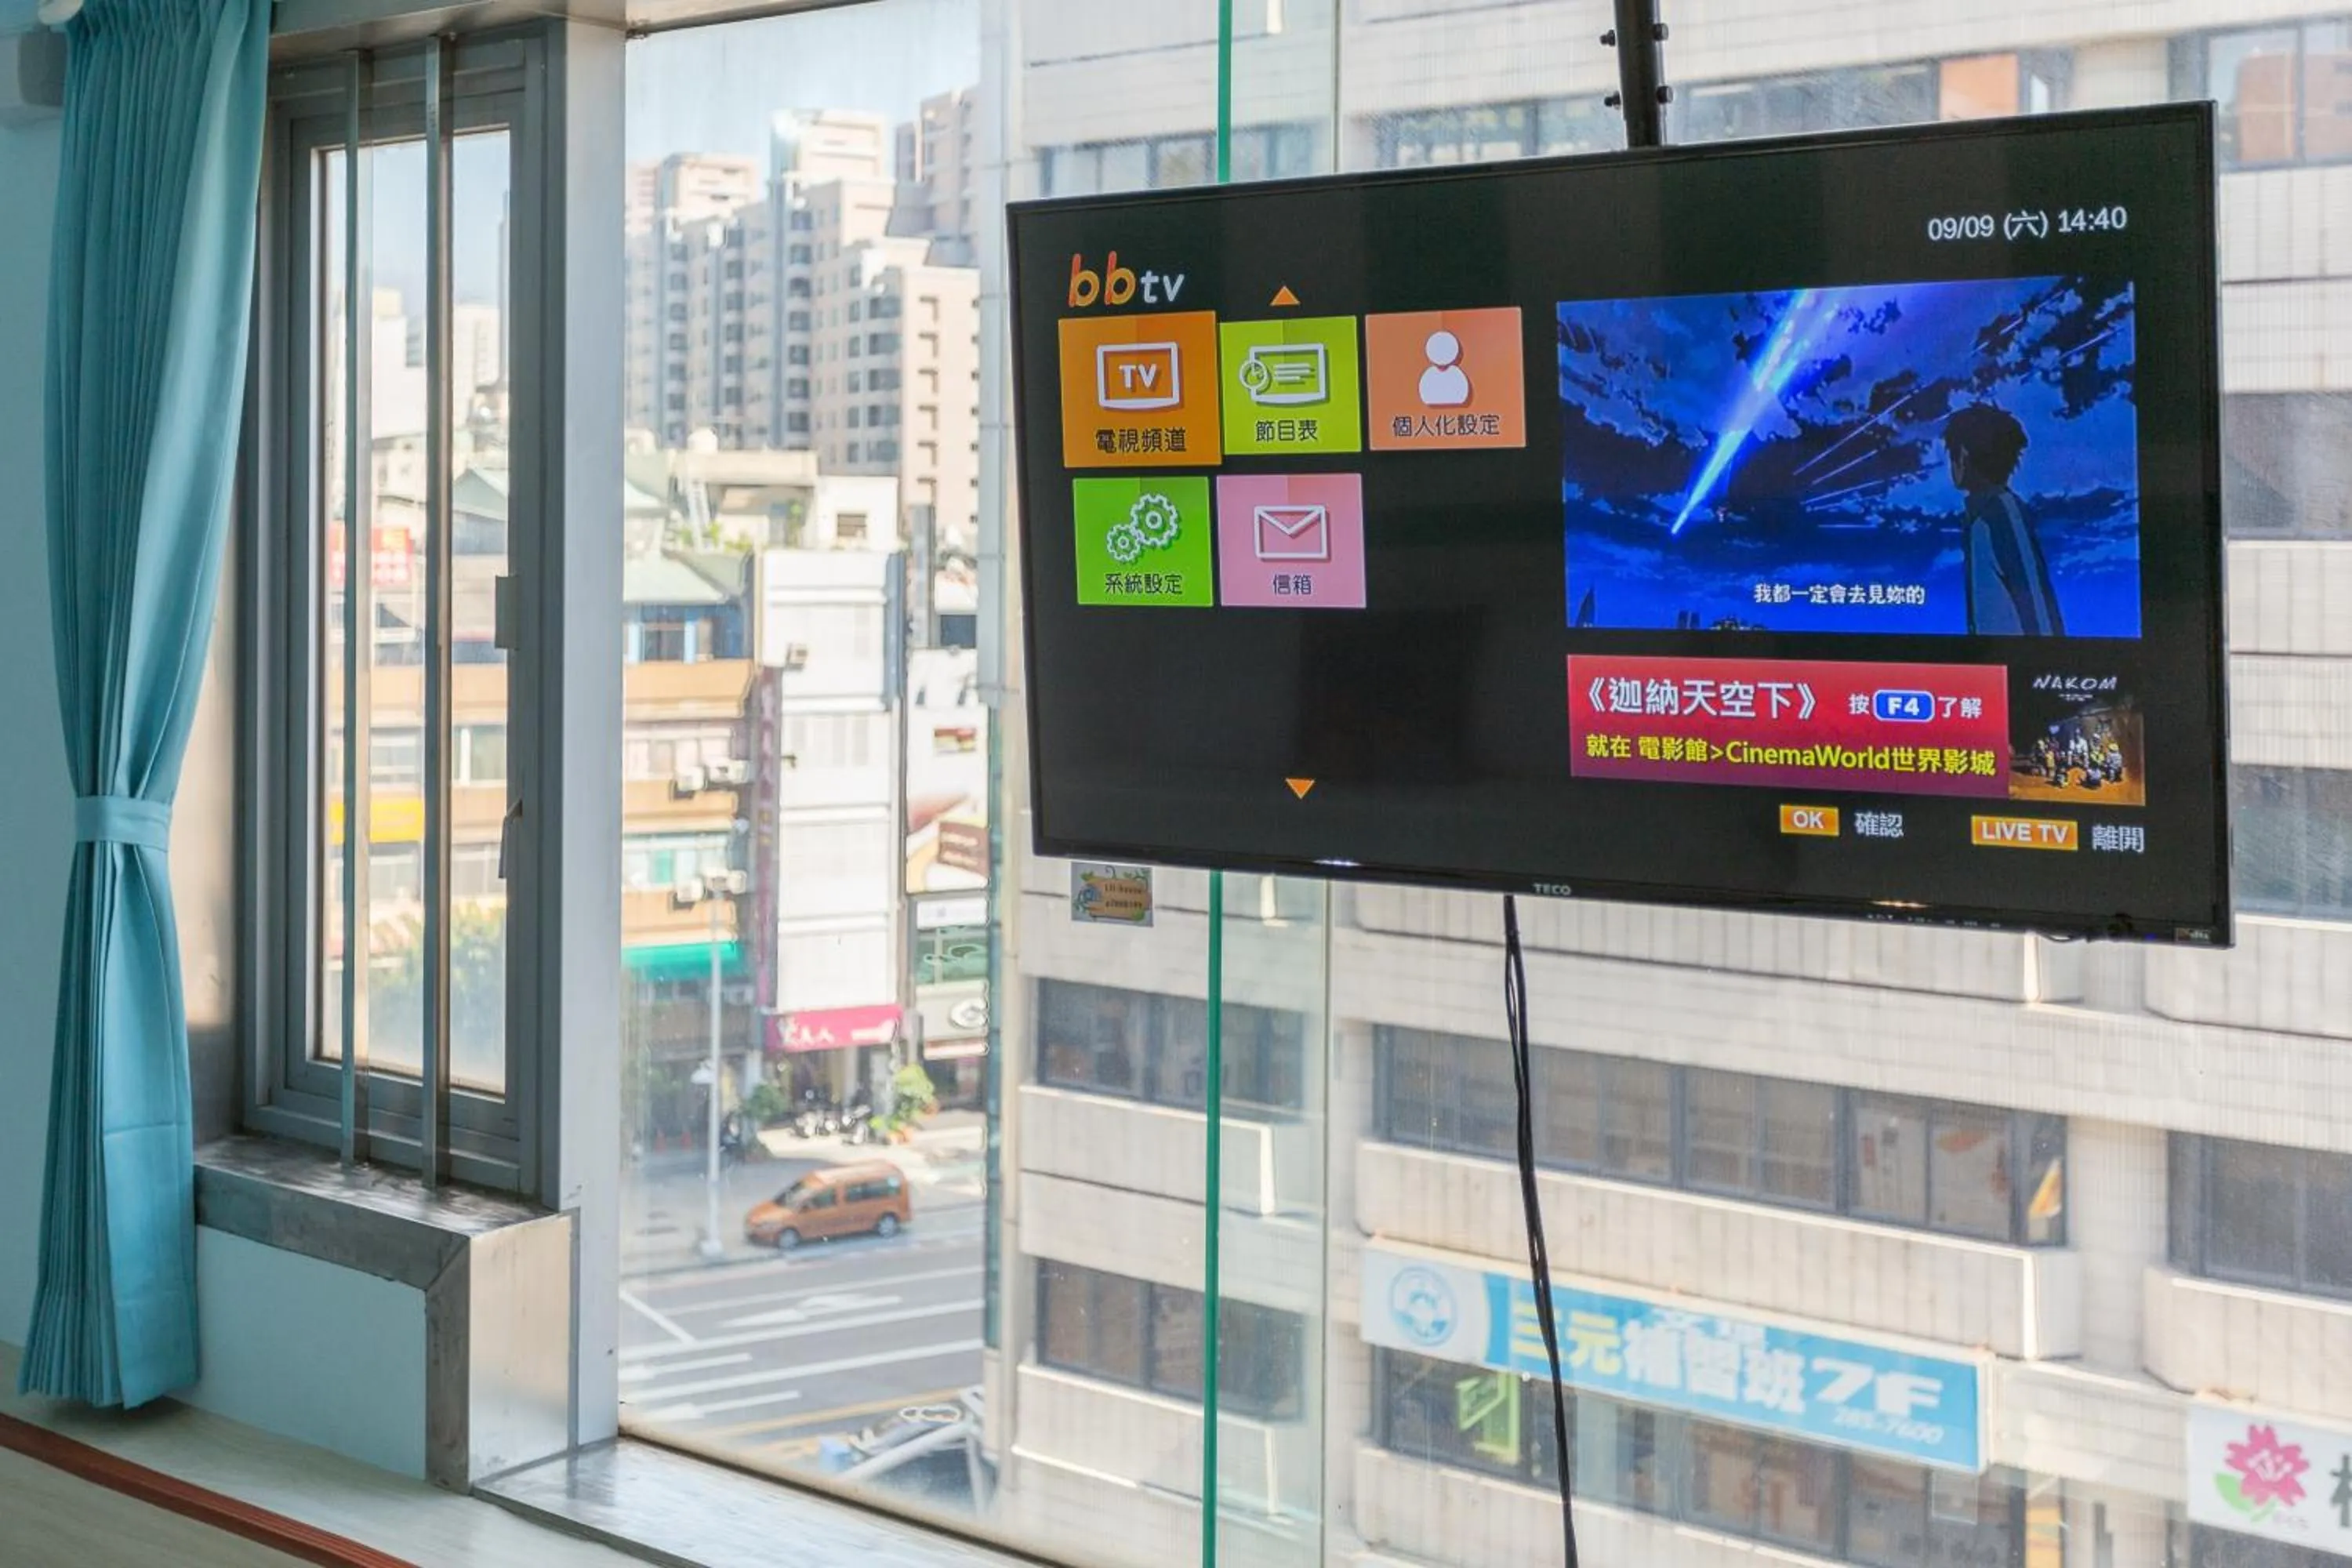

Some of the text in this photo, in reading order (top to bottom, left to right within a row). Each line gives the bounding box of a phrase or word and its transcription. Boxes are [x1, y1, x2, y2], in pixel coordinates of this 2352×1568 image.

[1928, 206, 2127, 240] 09/09 (六) 14:40
[1069, 251, 1185, 307] bbtv
[1119, 365, 1156, 389] TV
[1255, 419, 1318, 442] 節目表
[1392, 415, 1500, 437] 個人化設定
[1095, 427, 1187, 453] 電視頻道
[1105, 573, 1183, 595] 系統設定
[1272, 575, 1312, 595] 信箱
[1755, 583, 1926, 604] 我都一定會去見妳的
[2032, 674, 2117, 690] NAKOM
[1588, 677, 1816, 719] 《迦納天空下》
[1586, 735, 1632, 758] 就在
[1792, 811, 1824, 829] OK
[1855, 812, 1904, 838] 確認
[1980, 822, 2068, 843] LIVE TV
[2092, 826, 2144, 852] 離開
[1533, 883, 1571, 895] TECO
